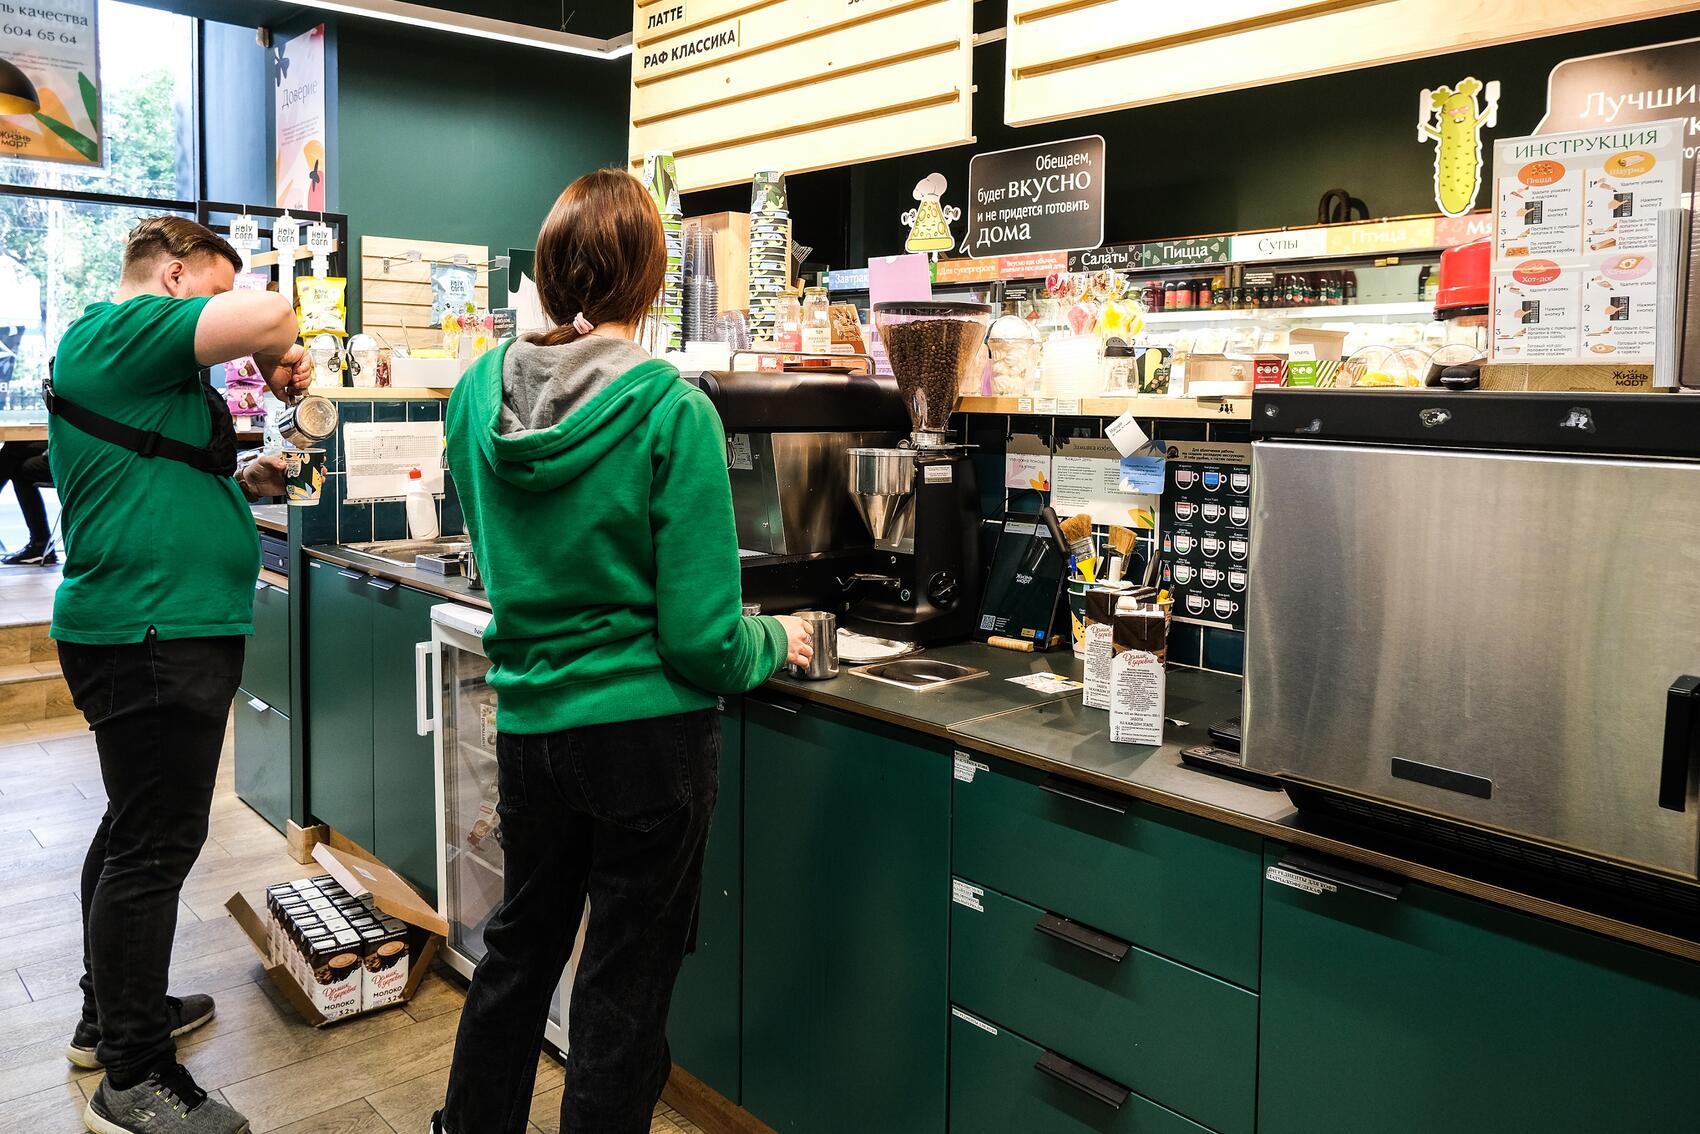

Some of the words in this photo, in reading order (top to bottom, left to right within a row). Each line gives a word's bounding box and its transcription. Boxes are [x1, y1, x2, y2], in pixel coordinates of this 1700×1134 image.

[19, 6, 88, 26] качества
[647, 6, 683, 29] ЛАТТЕ
[3, 24, 32, 37] 604
[38, 29, 55, 41] 65
[60, 33, 76, 44] 64
[644, 50, 668, 68] РАФ
[671, 29, 736, 62] КЛАССИКА
[281, 80, 318, 110] Доверие
[1580, 84, 1700, 122] Лучши
[1516, 130, 1658, 158] ИНСТРУКЦИЯ
[1036, 152, 1092, 171] Обещаем,
[978, 188, 1006, 206] будет
[977, 212, 983, 222] и
[985, 211, 996, 221] не
[999, 204, 1042, 223] придется
[1045, 200, 1090, 215] готовить
[1258, 238, 1298, 254] Супы
[1350, 230, 1408, 244] Птица
[1081, 252, 1128, 266] Салаты
[1163, 245, 1208, 260] Пицца
[1612, 370, 1648, 380] Жизнь
